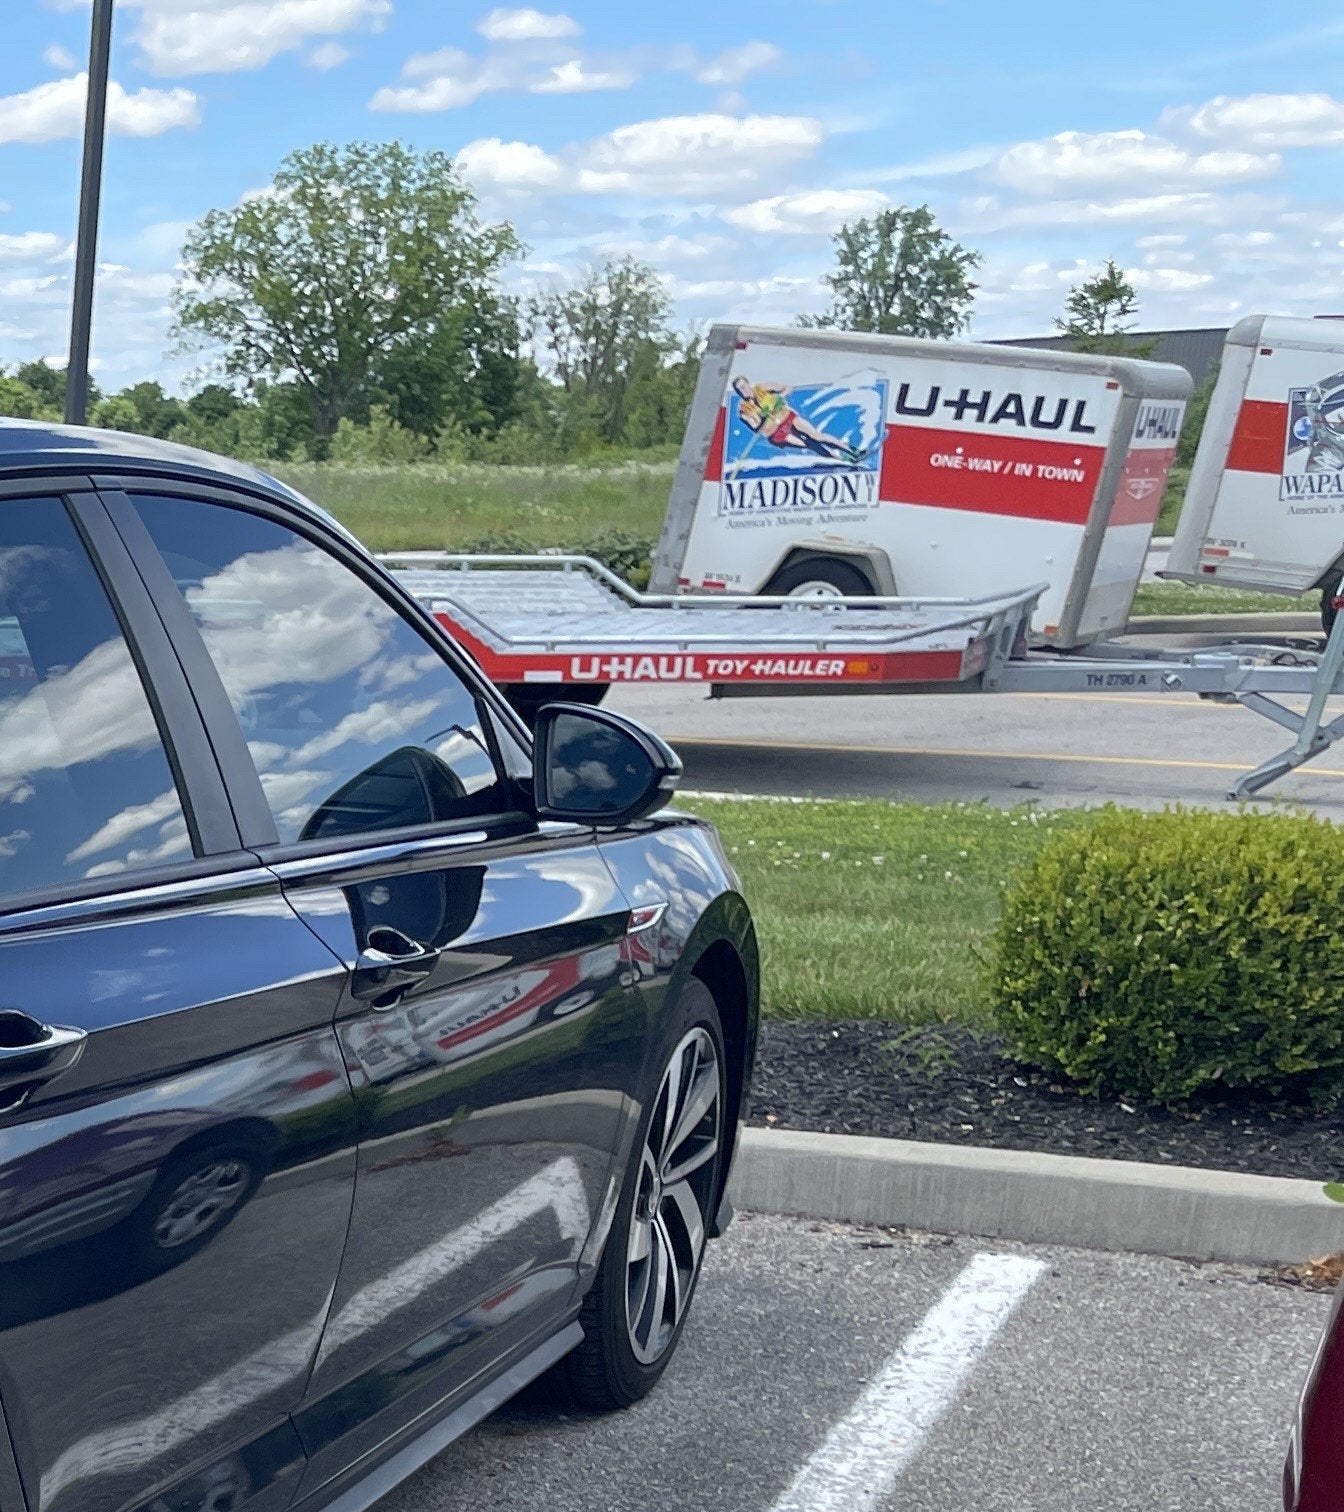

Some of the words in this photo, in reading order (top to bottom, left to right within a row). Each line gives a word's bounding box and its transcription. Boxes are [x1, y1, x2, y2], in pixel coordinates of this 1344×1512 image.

[895, 383, 1096, 434] U-HAUL
[929, 453, 1002, 475] ONE-WAY
[1014, 462, 1033, 477] IN
[1037, 464, 1085, 482] TOWN
[723, 473, 860, 510] MADISON
[570, 656, 704, 680] U-HAUL
